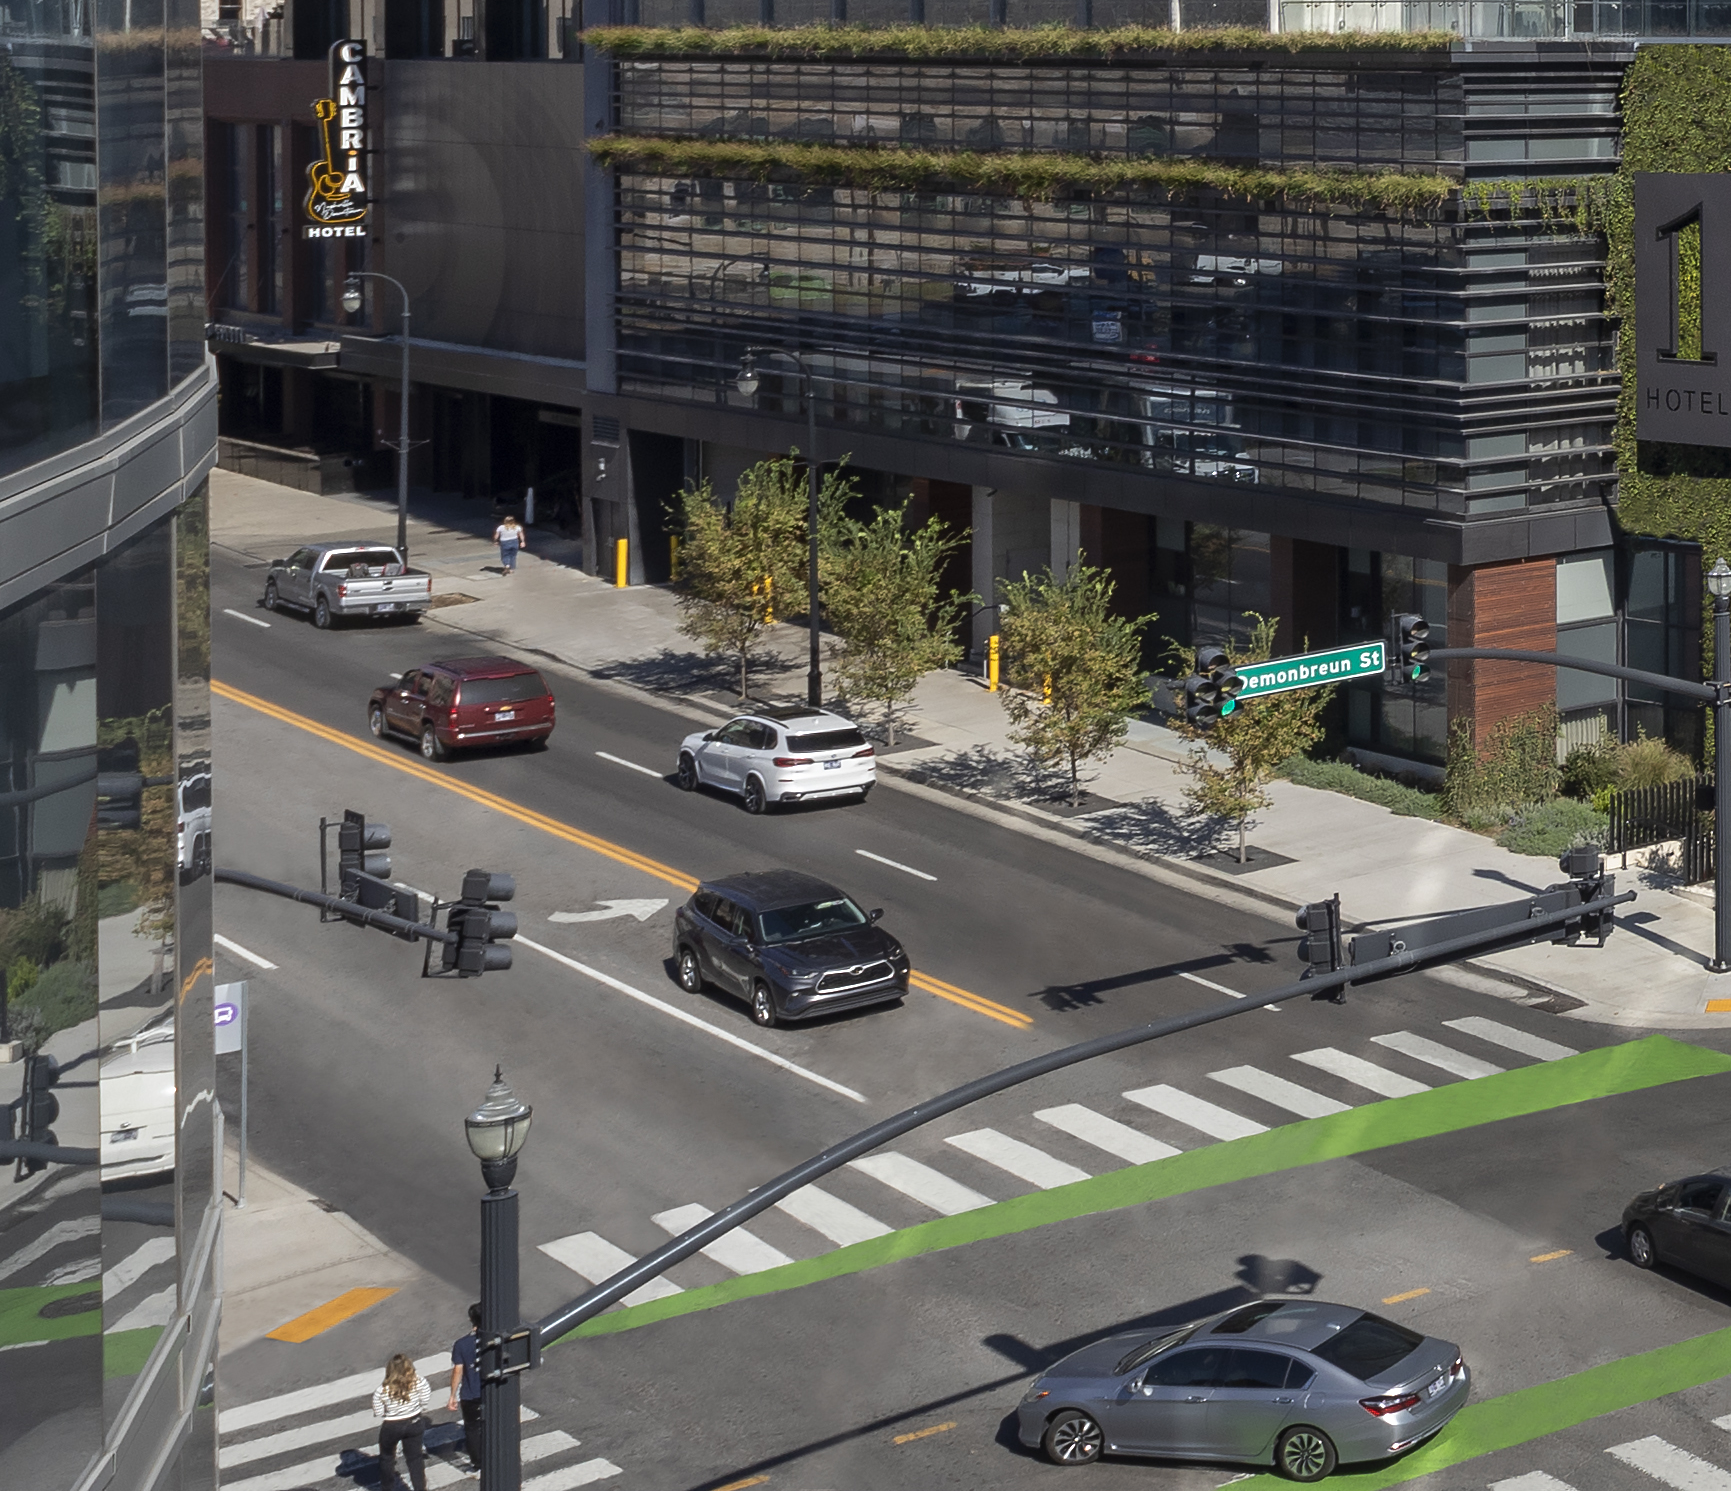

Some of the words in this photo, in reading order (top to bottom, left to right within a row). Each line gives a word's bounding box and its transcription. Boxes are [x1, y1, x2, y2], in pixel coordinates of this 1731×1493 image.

[308, 225, 367, 238] HOTEL
[1646, 386, 1729, 416] HOTEL
[1360, 650, 1380, 668] St
